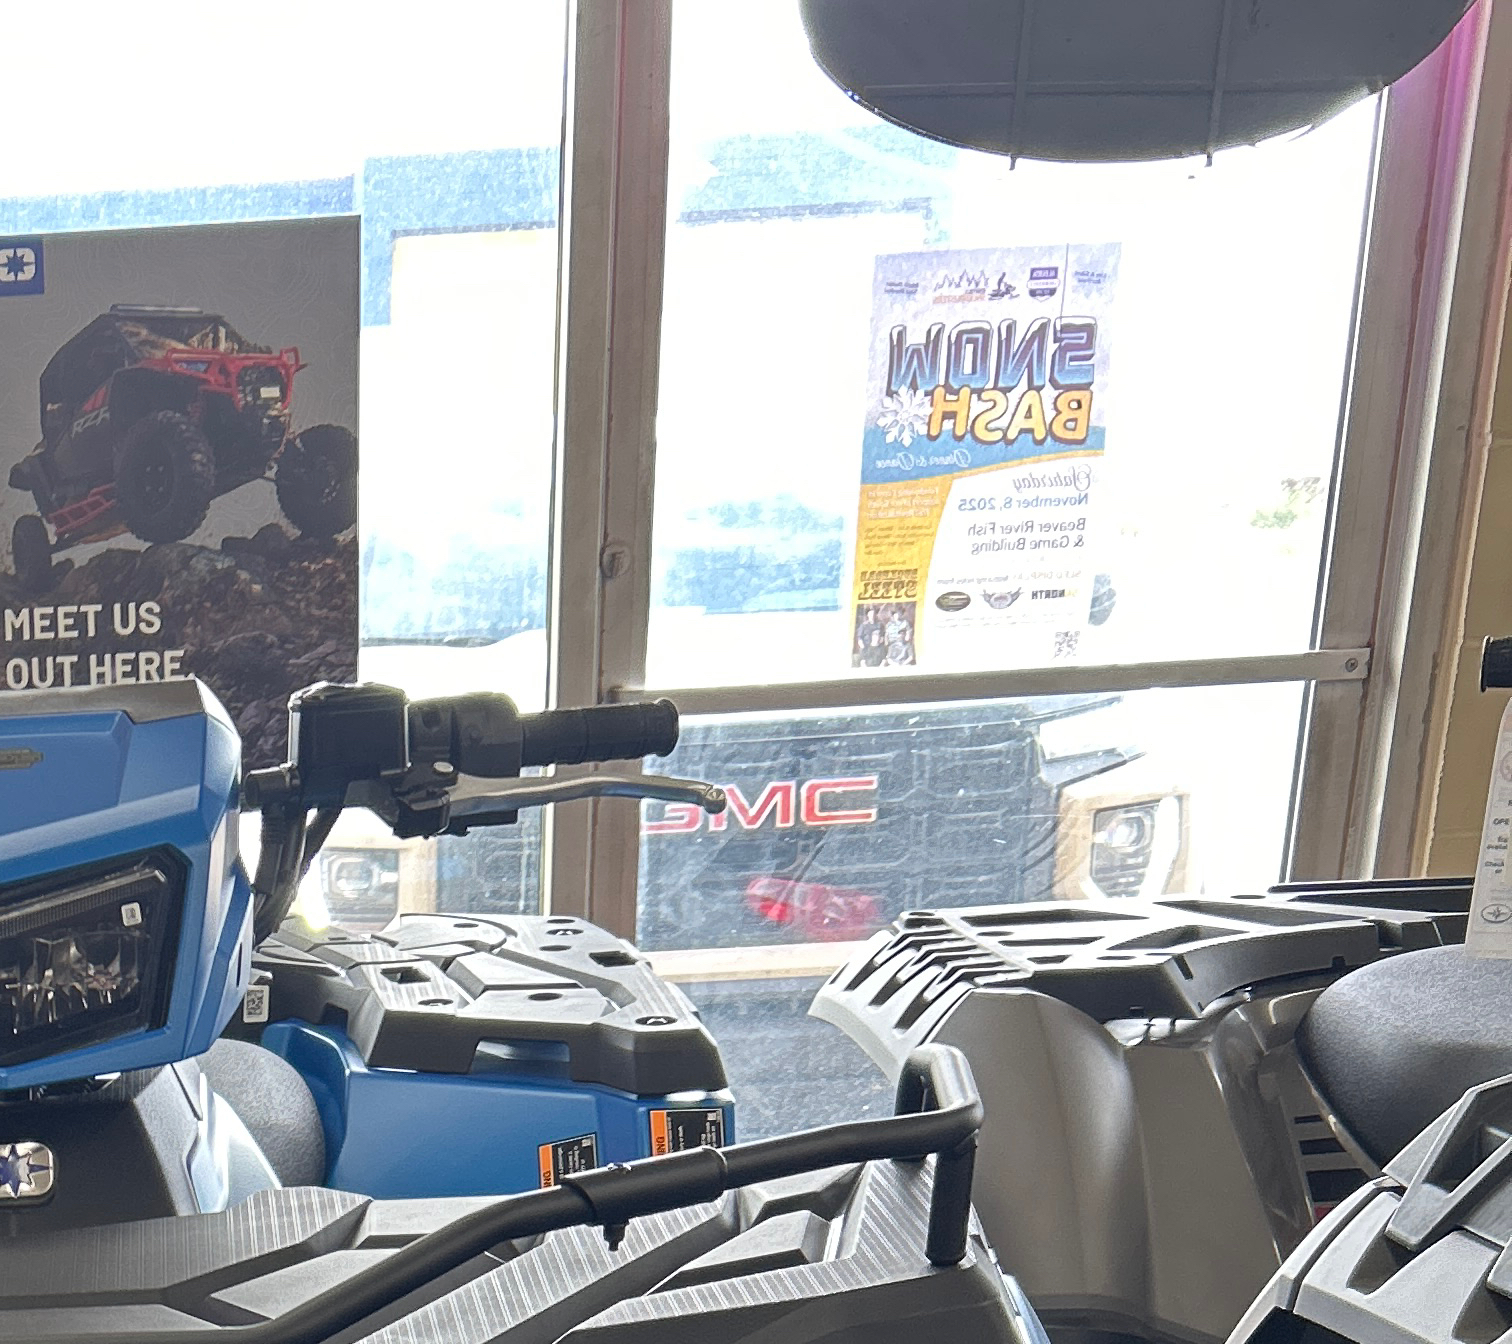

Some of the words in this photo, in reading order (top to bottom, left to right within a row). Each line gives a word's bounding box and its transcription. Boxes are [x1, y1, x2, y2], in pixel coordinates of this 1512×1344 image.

[4, 603, 102, 642] MEET
[114, 601, 162, 635] US
[6, 655, 78, 690] OUT
